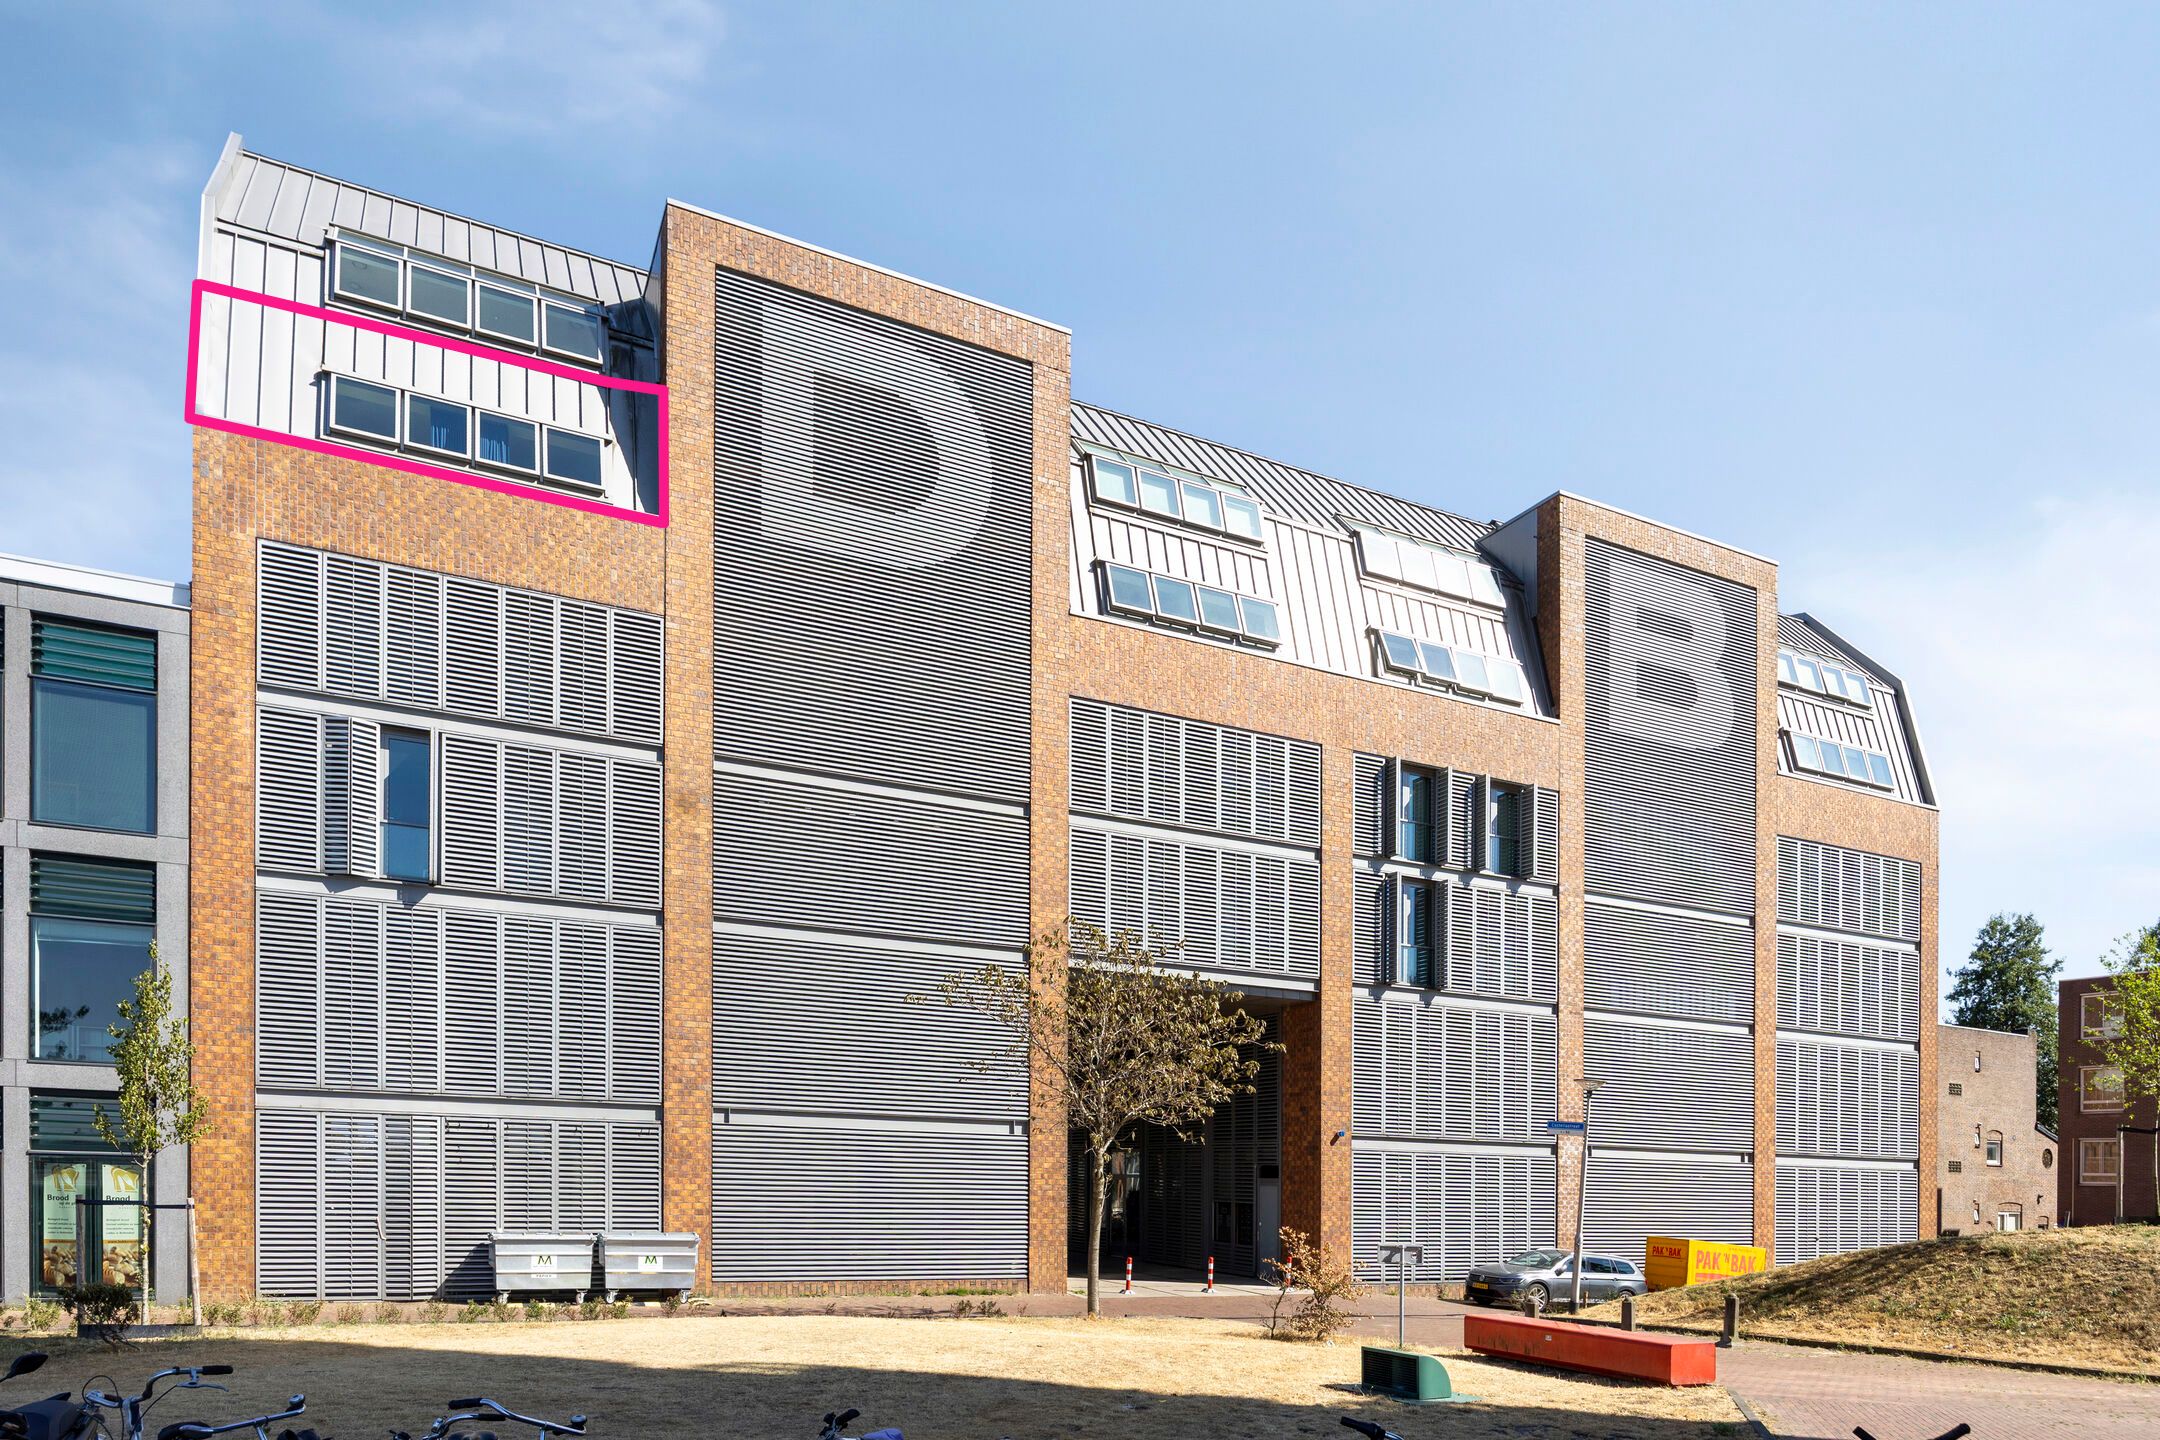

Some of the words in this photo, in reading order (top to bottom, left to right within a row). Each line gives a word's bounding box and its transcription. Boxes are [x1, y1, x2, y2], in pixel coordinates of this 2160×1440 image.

[1608, 558, 1737, 750] B
[1652, 1246, 1665, 1255] PAK
[1696, 1249, 1721, 1270] PAK
[1730, 1254, 1756, 1274] BAK
